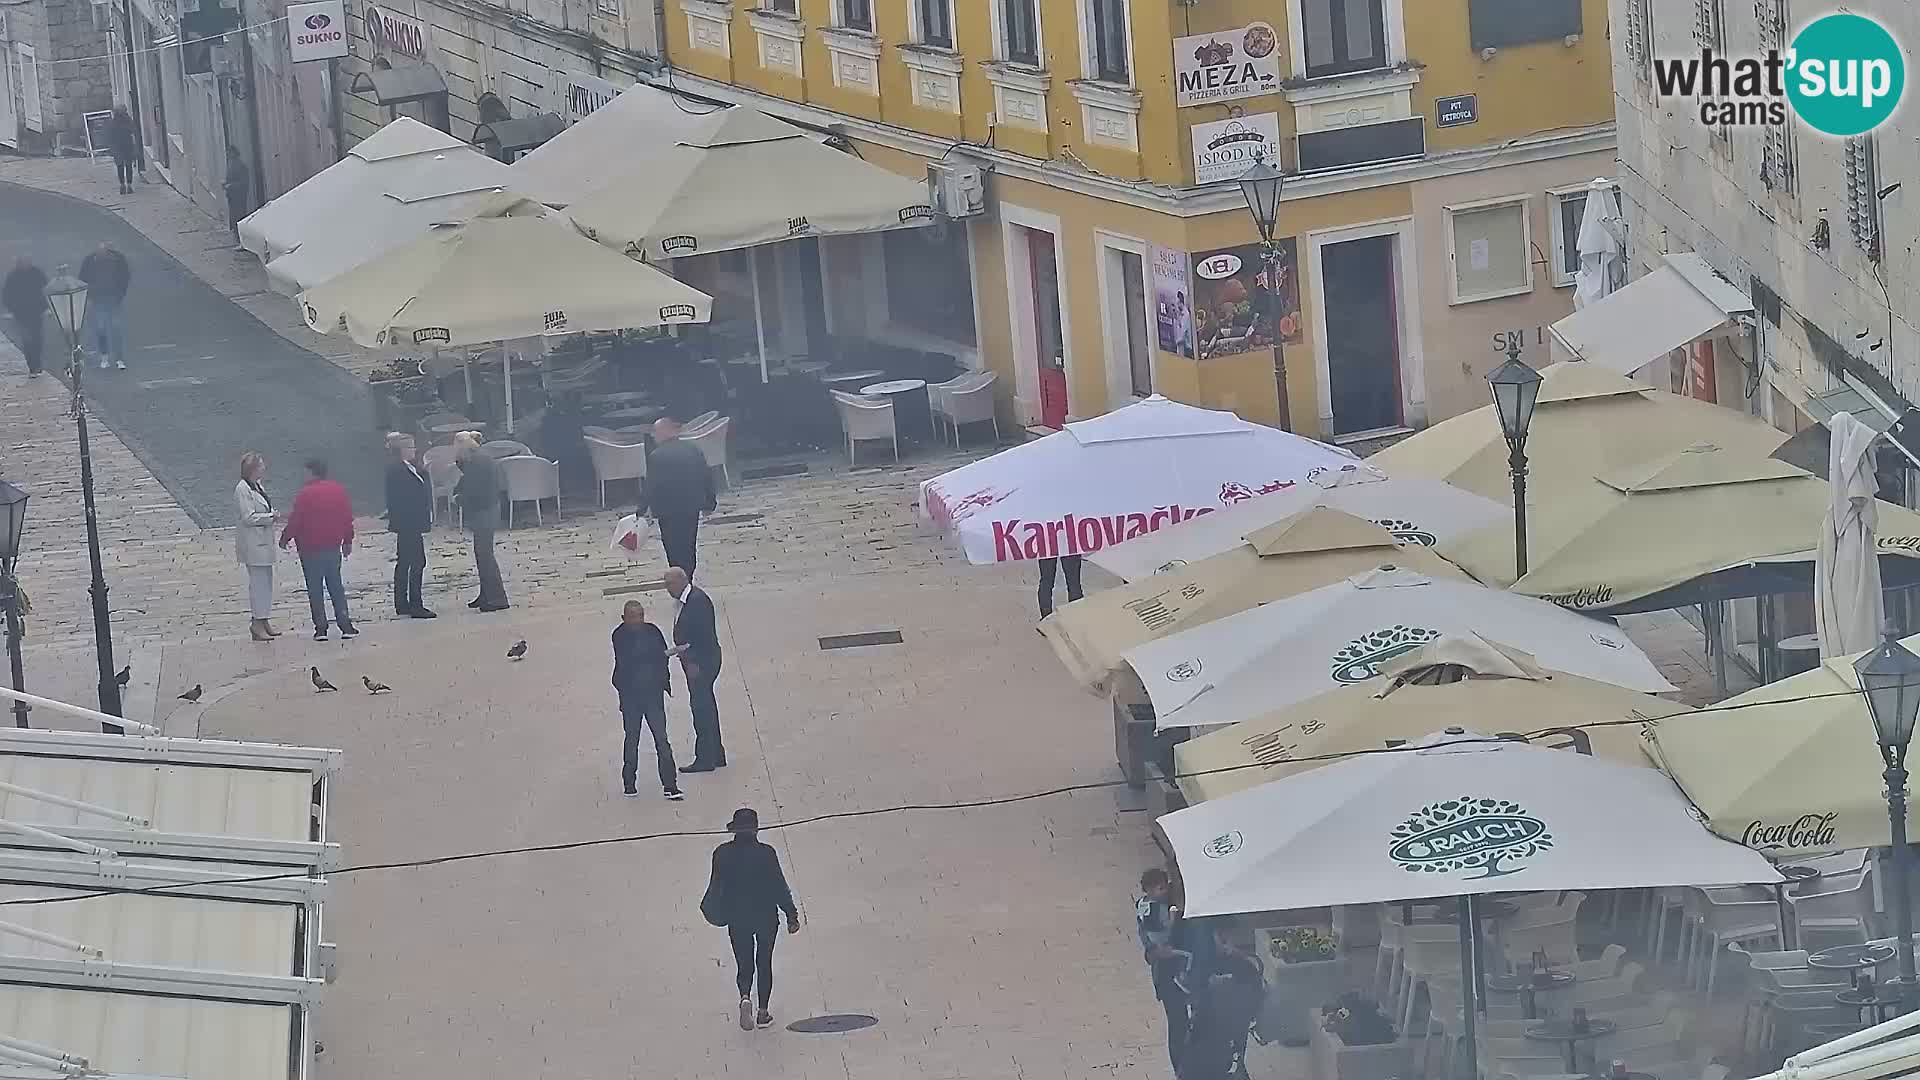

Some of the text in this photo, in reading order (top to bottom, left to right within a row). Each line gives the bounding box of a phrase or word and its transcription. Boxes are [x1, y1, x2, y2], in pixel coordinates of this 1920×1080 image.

[297, 31, 342, 45] SUKNO
[383, 15, 423, 56] SUKNO
[1180, 62, 1258, 92] MEZA
[1189, 88, 1221, 100] PIZZERIA
[1229, 84, 1250, 95] GRILL
[1199, 148, 1243, 166] ISPOD
[1248, 142, 1277, 158] URE
[991, 503, 1216, 562] Karlovač
[1429, 821, 1528, 853] RAUCH
